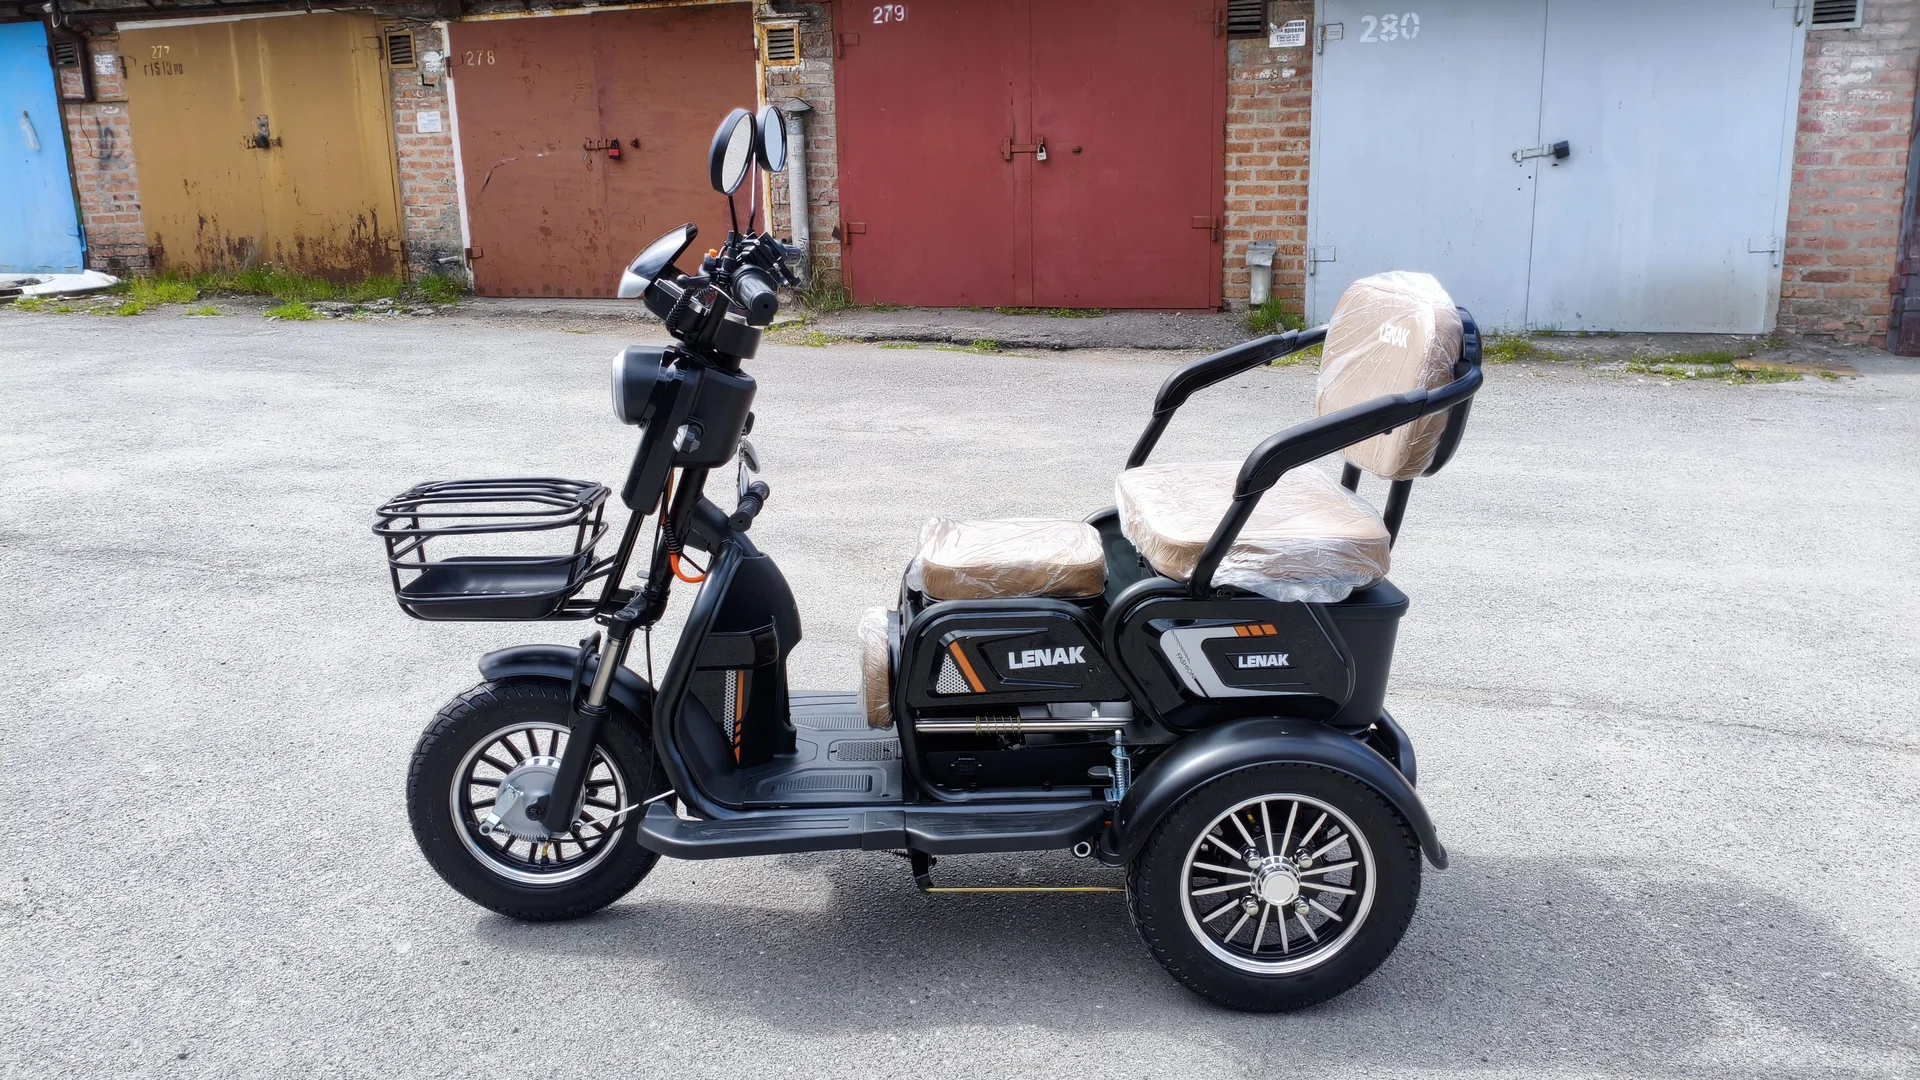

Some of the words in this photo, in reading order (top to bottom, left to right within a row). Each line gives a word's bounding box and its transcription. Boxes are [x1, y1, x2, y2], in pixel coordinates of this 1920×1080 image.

[872, 4, 905, 24] 279
[1360, 12, 1420, 43] 280
[150, 45, 170, 59] 277
[466, 49, 496, 66] 278
[1379, 322, 1411, 349] LENAK
[1008, 646, 1087, 670] LENAK
[1175, 652, 1196, 680] FASHION
[1238, 653, 1290, 669] LENAK
